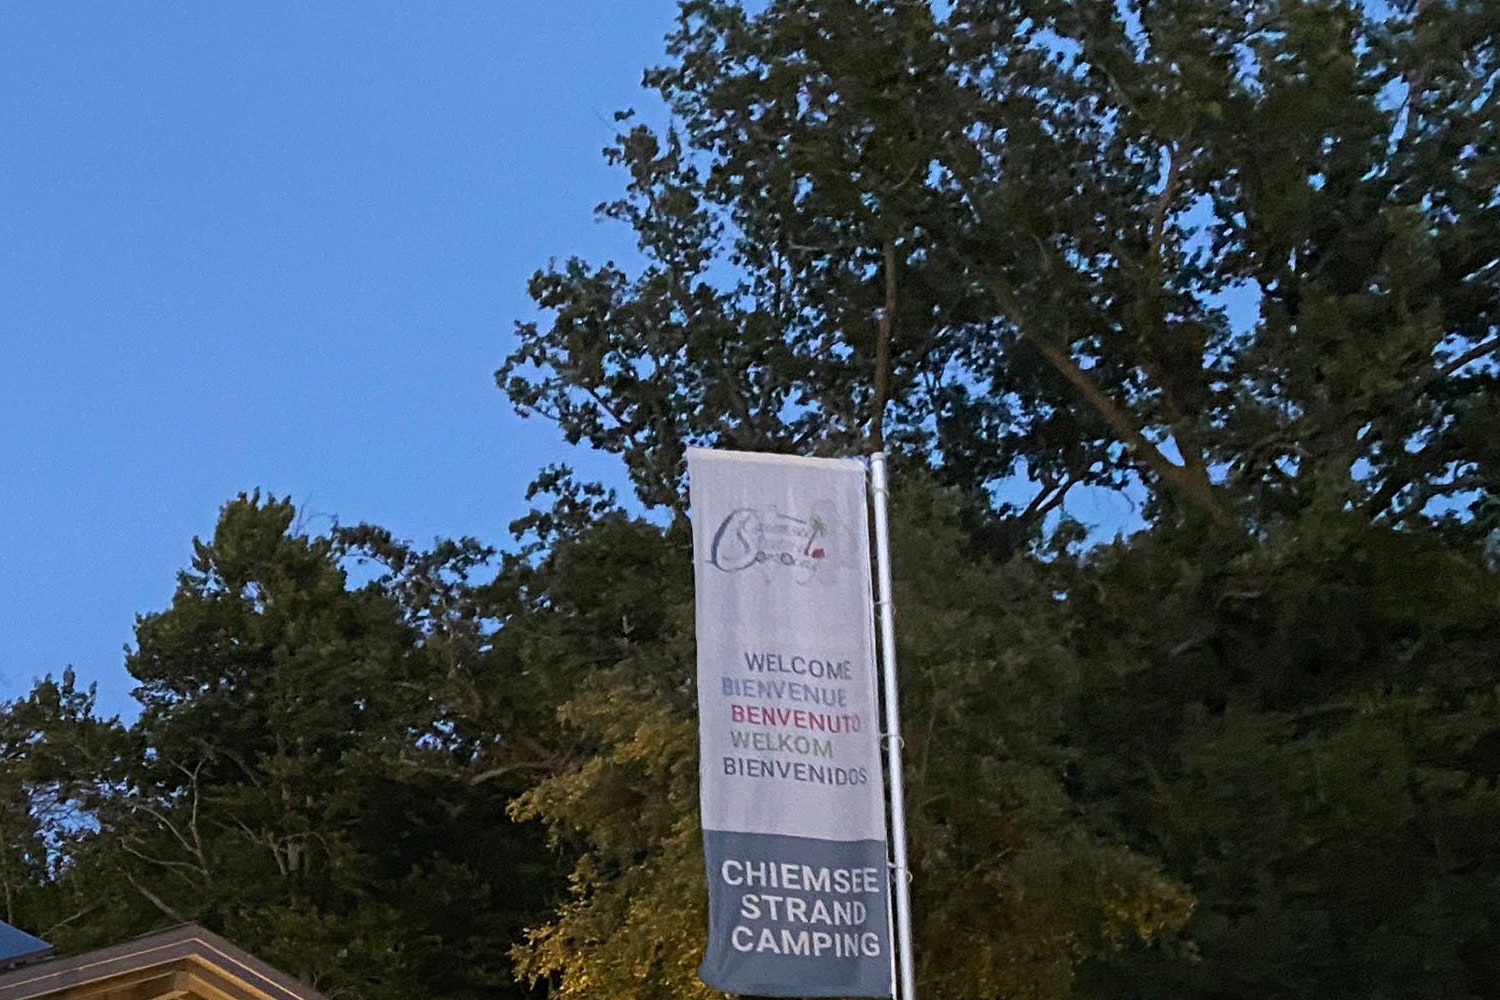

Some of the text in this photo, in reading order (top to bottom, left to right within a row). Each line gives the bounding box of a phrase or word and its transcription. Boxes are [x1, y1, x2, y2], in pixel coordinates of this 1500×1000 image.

[744, 652, 852, 680] WELCOME
[721, 676, 847, 707] BIENVENUE
[731, 704, 861, 734] BENVENUTO
[730, 730, 834, 759] WELKOM
[723, 756, 868, 786] BIENVENIDOS
[721, 859, 880, 894] CHIEMSEE
[740, 893, 867, 926] STRAND
[731, 925, 881, 958] CAMPING
